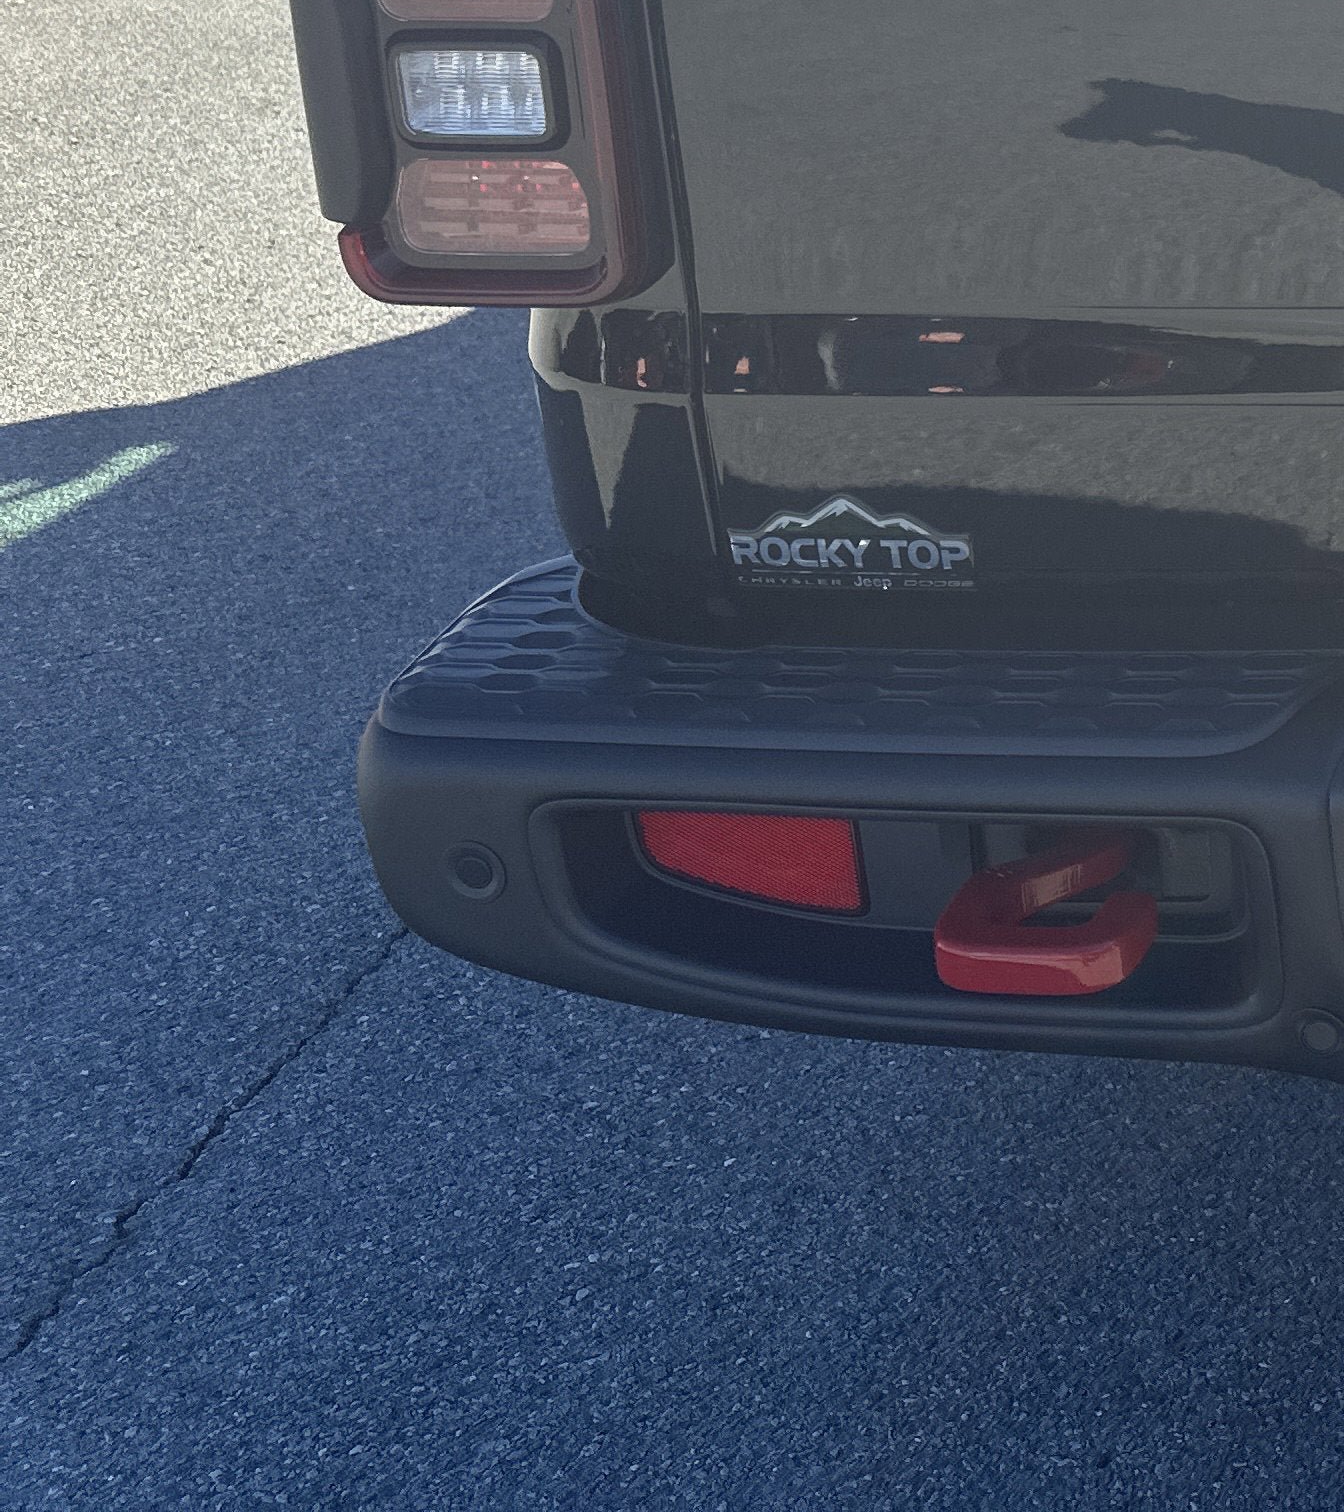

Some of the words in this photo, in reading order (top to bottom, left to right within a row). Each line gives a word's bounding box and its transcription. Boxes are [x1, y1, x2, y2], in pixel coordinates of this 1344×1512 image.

[730, 536, 871, 569] ROCKY
[879, 539, 970, 570] TOP
[853, 576, 893, 590] Jeep
[903, 579, 974, 587] DODGE
